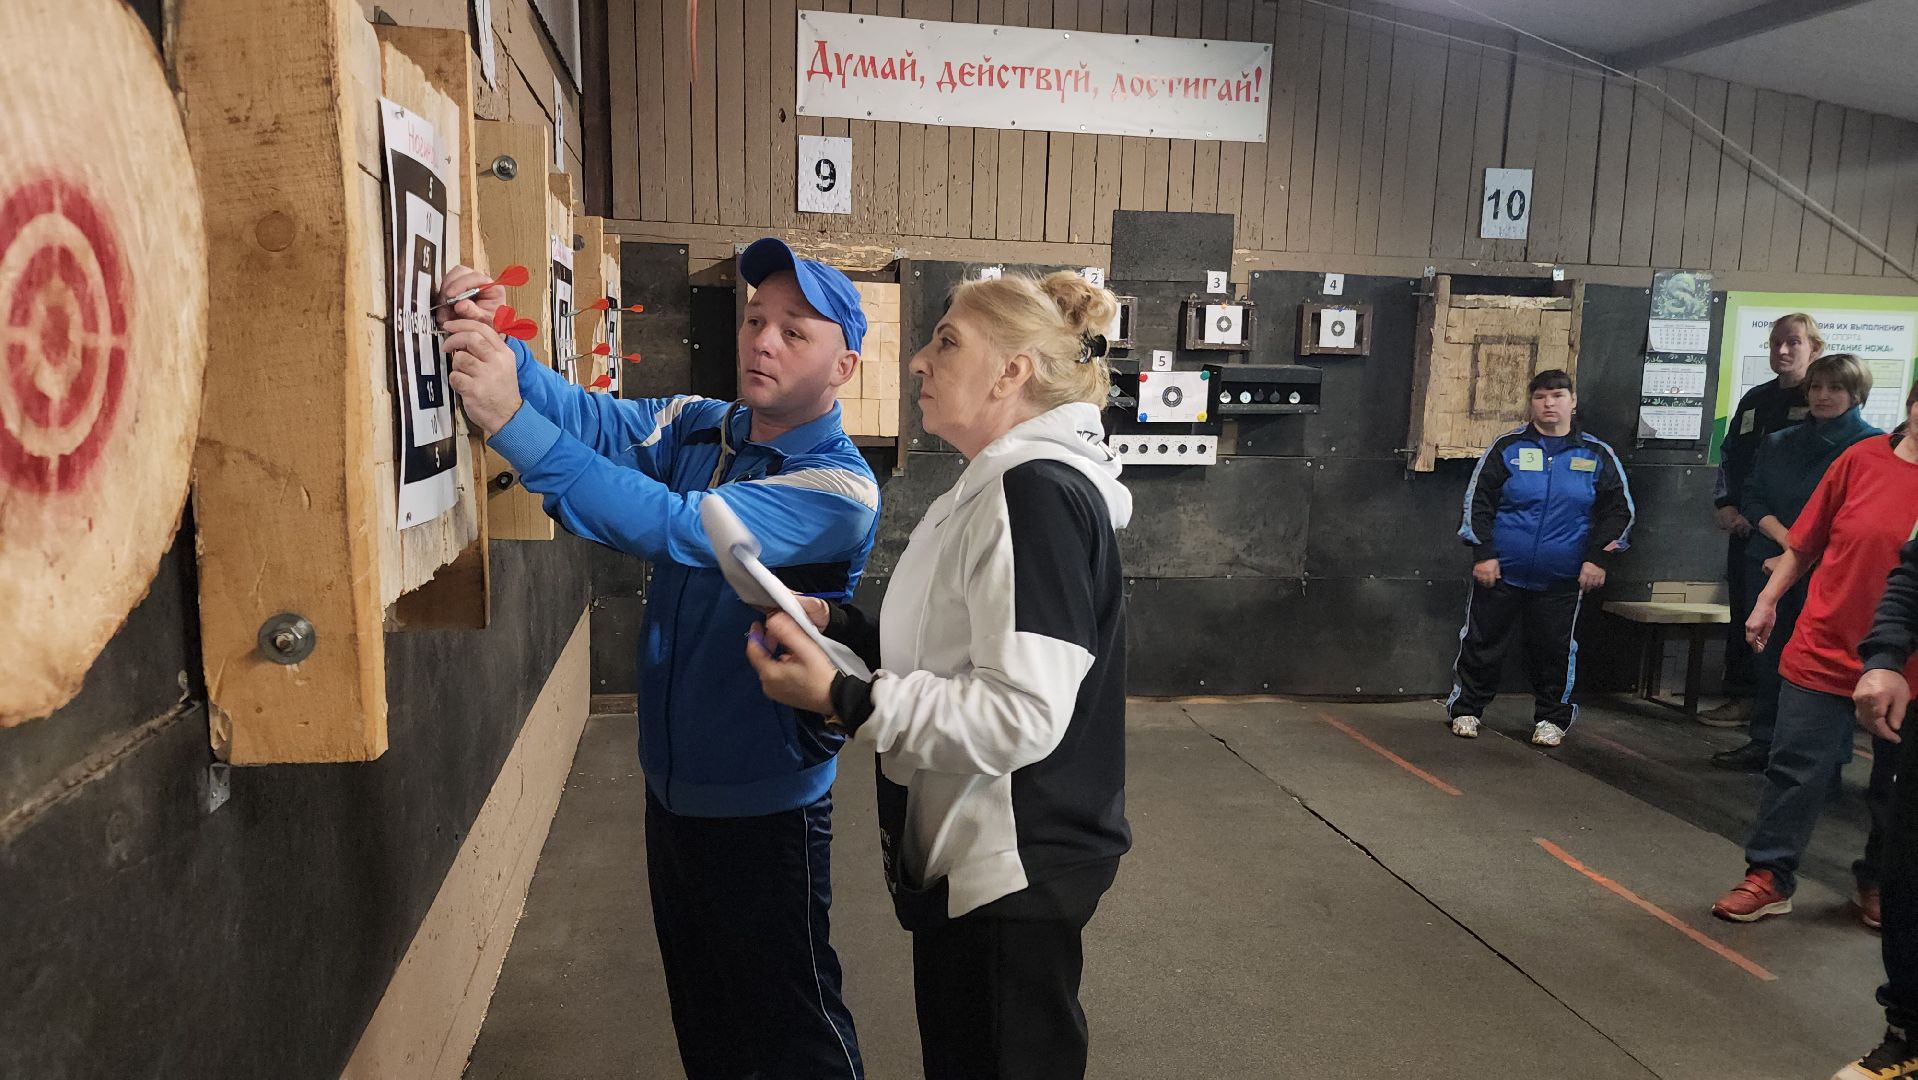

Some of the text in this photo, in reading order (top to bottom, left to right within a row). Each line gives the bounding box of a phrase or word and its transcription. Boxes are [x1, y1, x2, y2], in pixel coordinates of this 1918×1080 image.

[806, 40, 1263, 103] Думай, действуй, достигай!
[815, 158, 837, 193] 9
[428, 176, 434, 200] 5
[1487, 188, 1526, 221] 10
[425, 210, 432, 234] 10
[422, 244, 431, 269] 15
[1090, 272, 1099, 285] 2
[1213, 277, 1221, 289] 3
[1329, 279, 1338, 291] 4
[397, 307, 403, 332] 5
[1850, 323, 1905, 332] ВЫПОЛНЕНИЯ
[1158, 355, 1166, 367] 5
[426, 380, 435, 402] 15
[430, 413, 438, 436] 10
[434, 446, 441, 469] 5
[1526, 452, 1535, 463] 3
